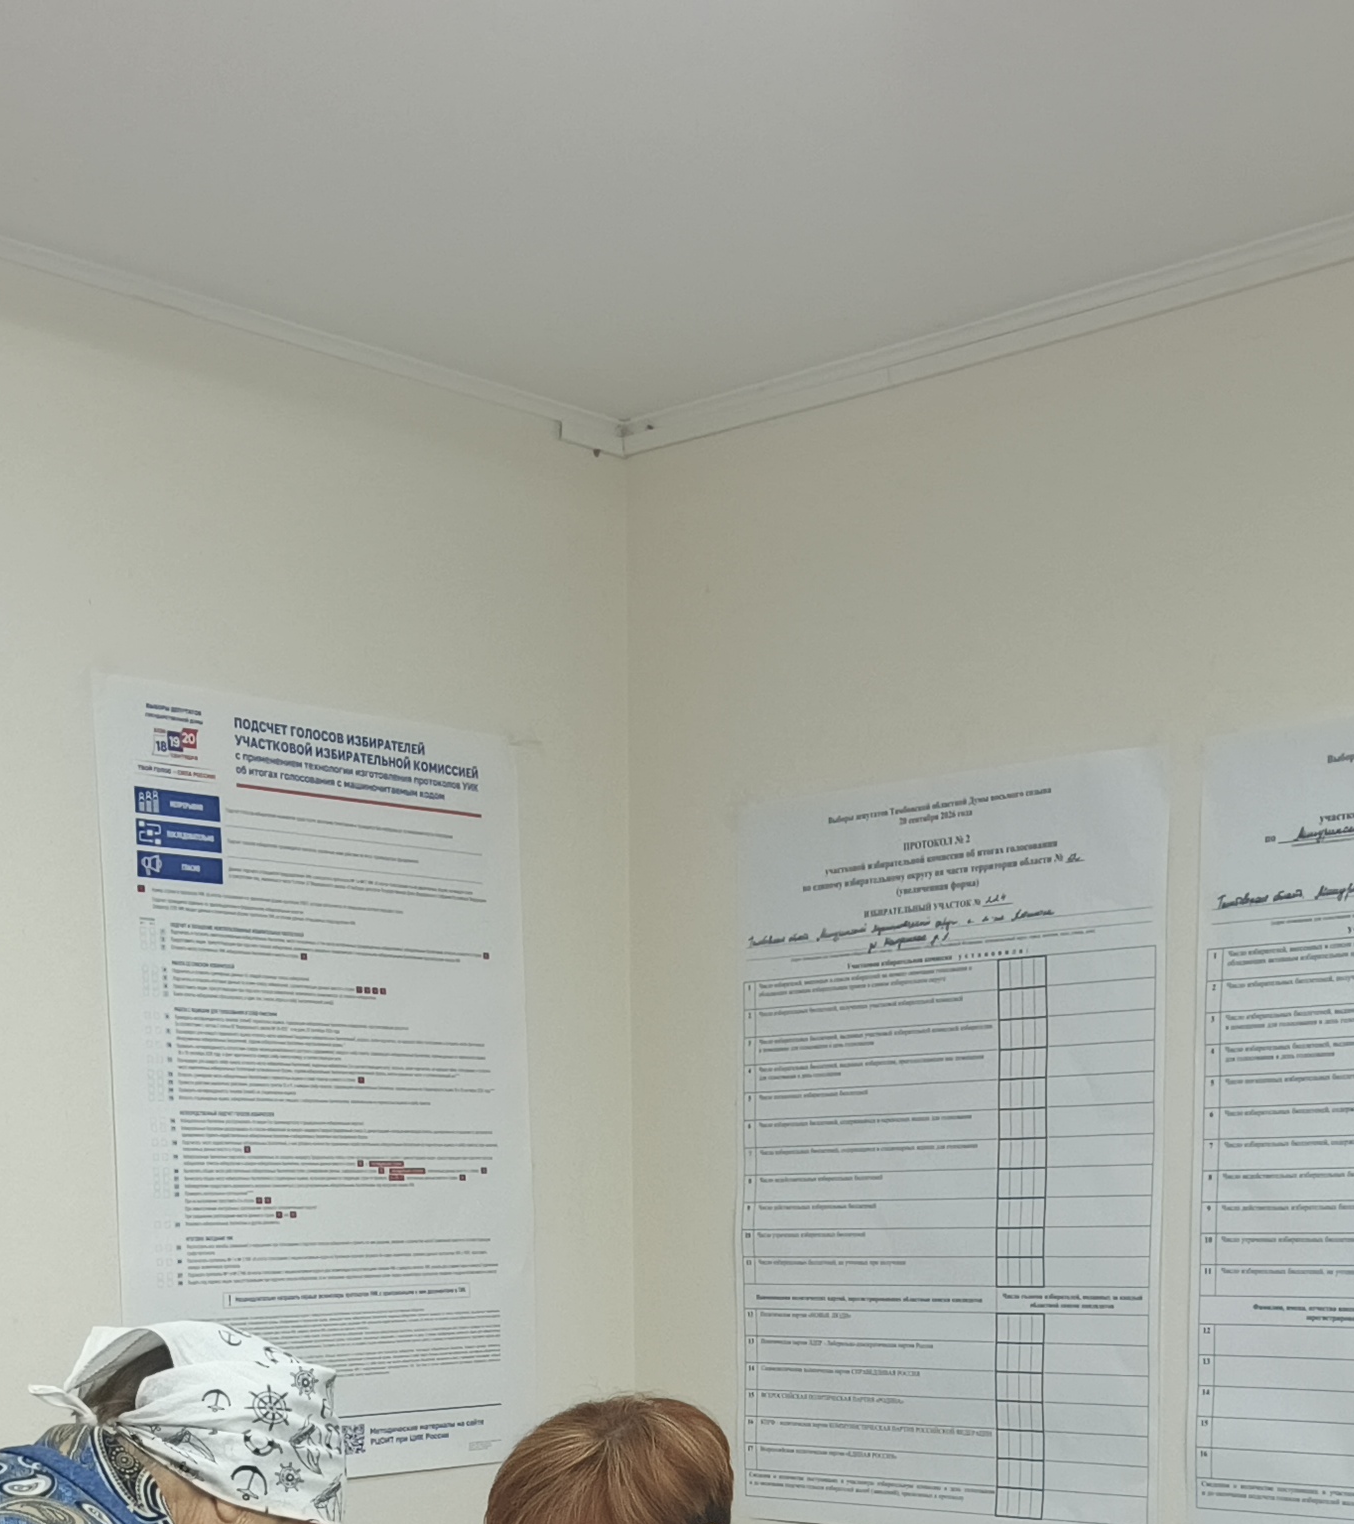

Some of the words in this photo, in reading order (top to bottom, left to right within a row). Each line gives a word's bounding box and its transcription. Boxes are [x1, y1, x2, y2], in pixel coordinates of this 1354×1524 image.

[156, 740, 167, 752] 18
[168, 736, 180, 747] 19
[182, 732, 195, 744] 20
[233, 716, 288, 736] ПОДСЧЕТ
[289, 725, 344, 744] ГОЛОСОВ
[346, 733, 425, 756] ИЗБИРАТЕЛЕЙ
[234, 734, 313, 757] УЧАСТКОВОЙ
[315, 746, 411, 770] ИЗБИРАТЕЛЬНОЙ
[412, 759, 479, 779] КОМИССИЕЙ
[903, 836, 953, 851] ПРОТОКОЛ
[954, 834, 964, 845] №
[965, 833, 970, 843] 2
